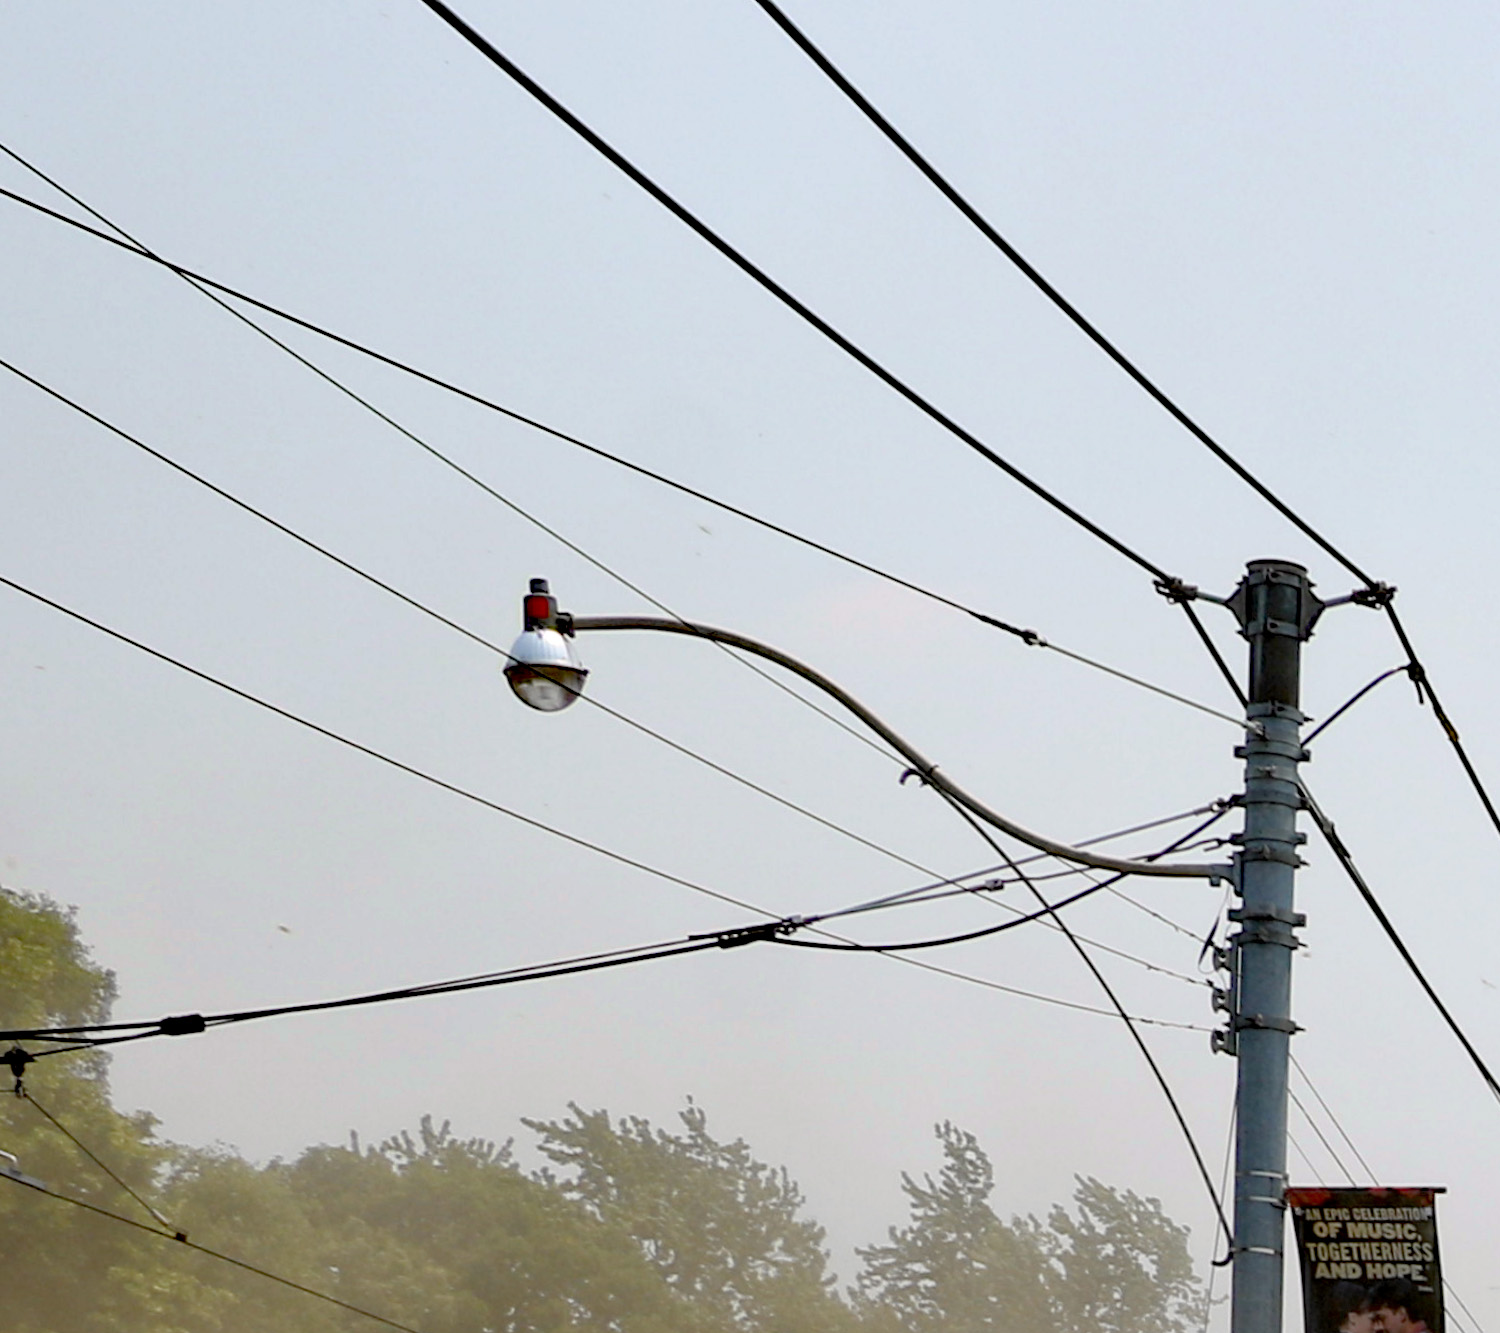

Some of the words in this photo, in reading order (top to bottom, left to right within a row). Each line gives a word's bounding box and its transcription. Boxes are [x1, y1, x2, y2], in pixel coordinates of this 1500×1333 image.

[1305, 1207, 1322, 1220] AN
[1323, 1207, 1351, 1221] EPIC
[1352, 1207, 1430, 1221] CELEBRATION
[1313, 1221, 1342, 1239] OF
[1346, 1221, 1422, 1242] MUSIC,
[1304, 1241, 1434, 1263] TOGETHERNESS
[1314, 1262, 1363, 1280] AND
